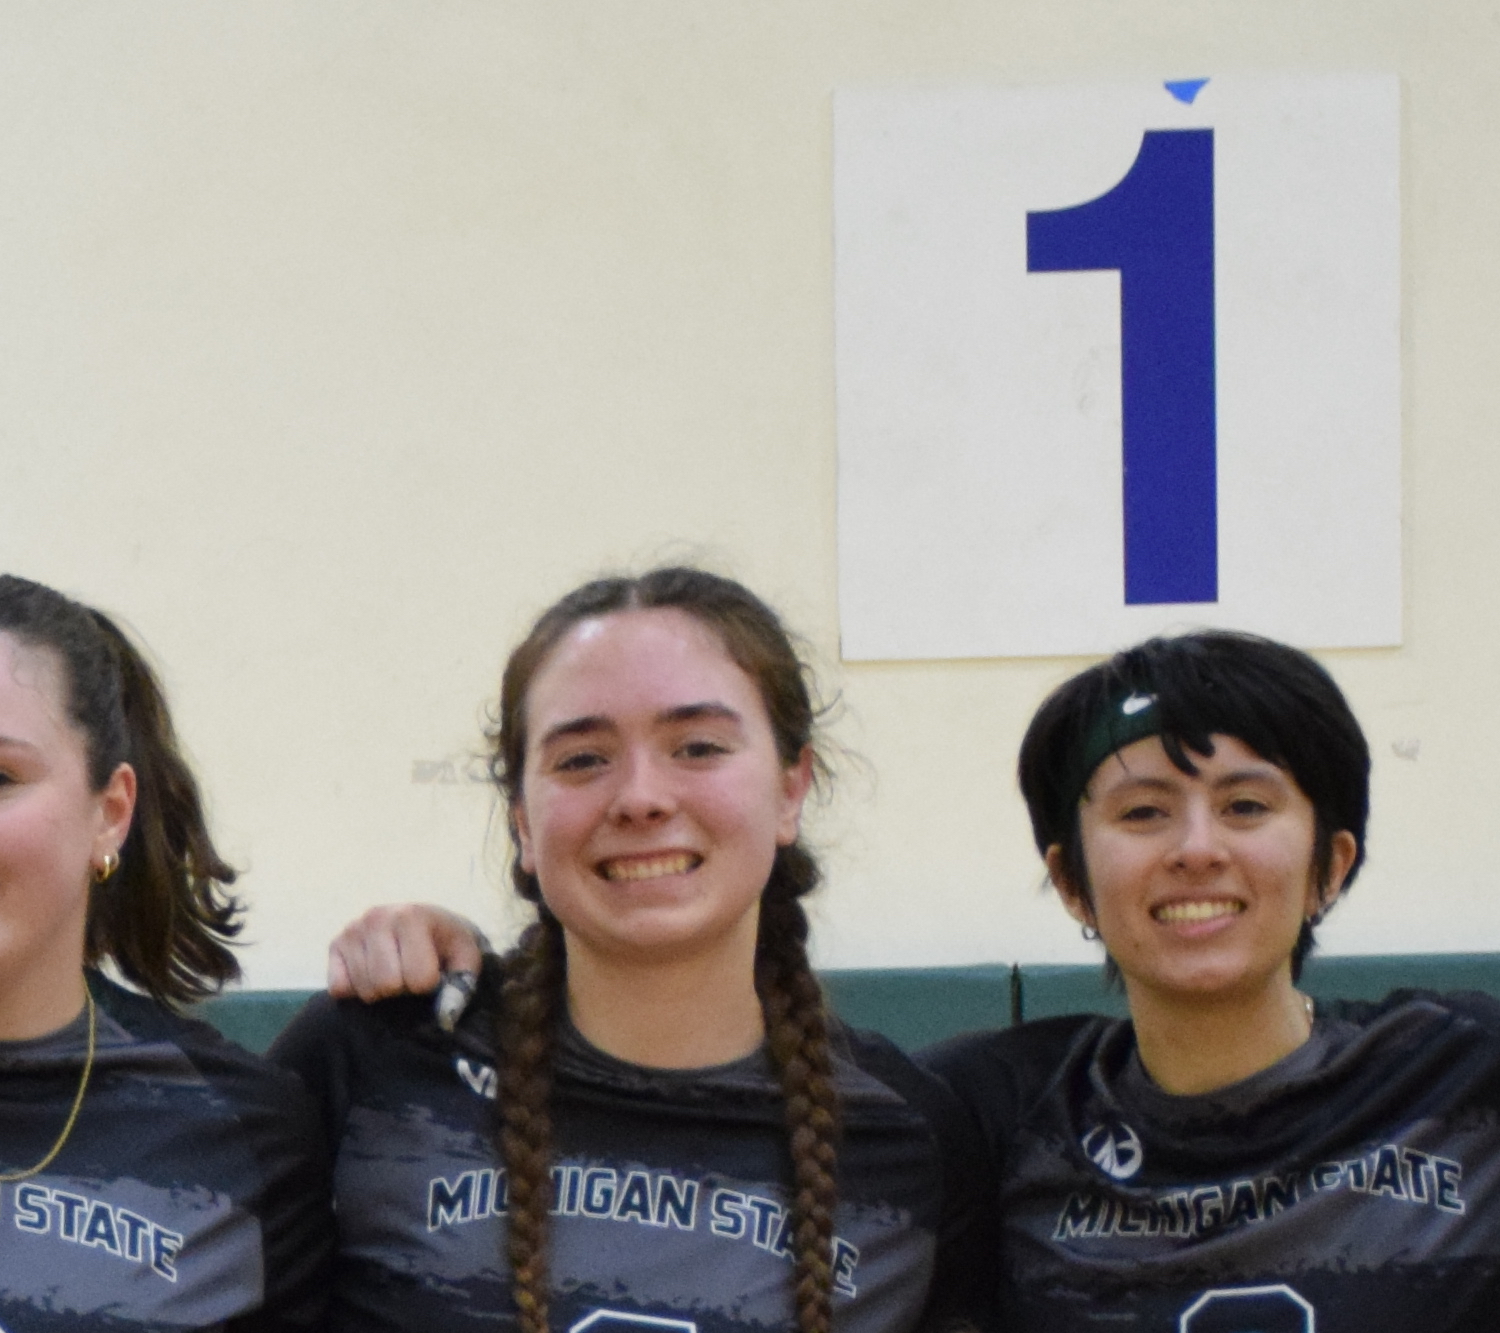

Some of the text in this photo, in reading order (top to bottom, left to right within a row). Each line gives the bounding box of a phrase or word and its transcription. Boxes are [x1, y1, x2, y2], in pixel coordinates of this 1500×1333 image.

[1026, 127, 1218, 606] 1
[15, 1182, 183, 1283] STATE
[710, 1188, 860, 1299] STAE
[1052, 1175, 1299, 1241] MICHIGAN
